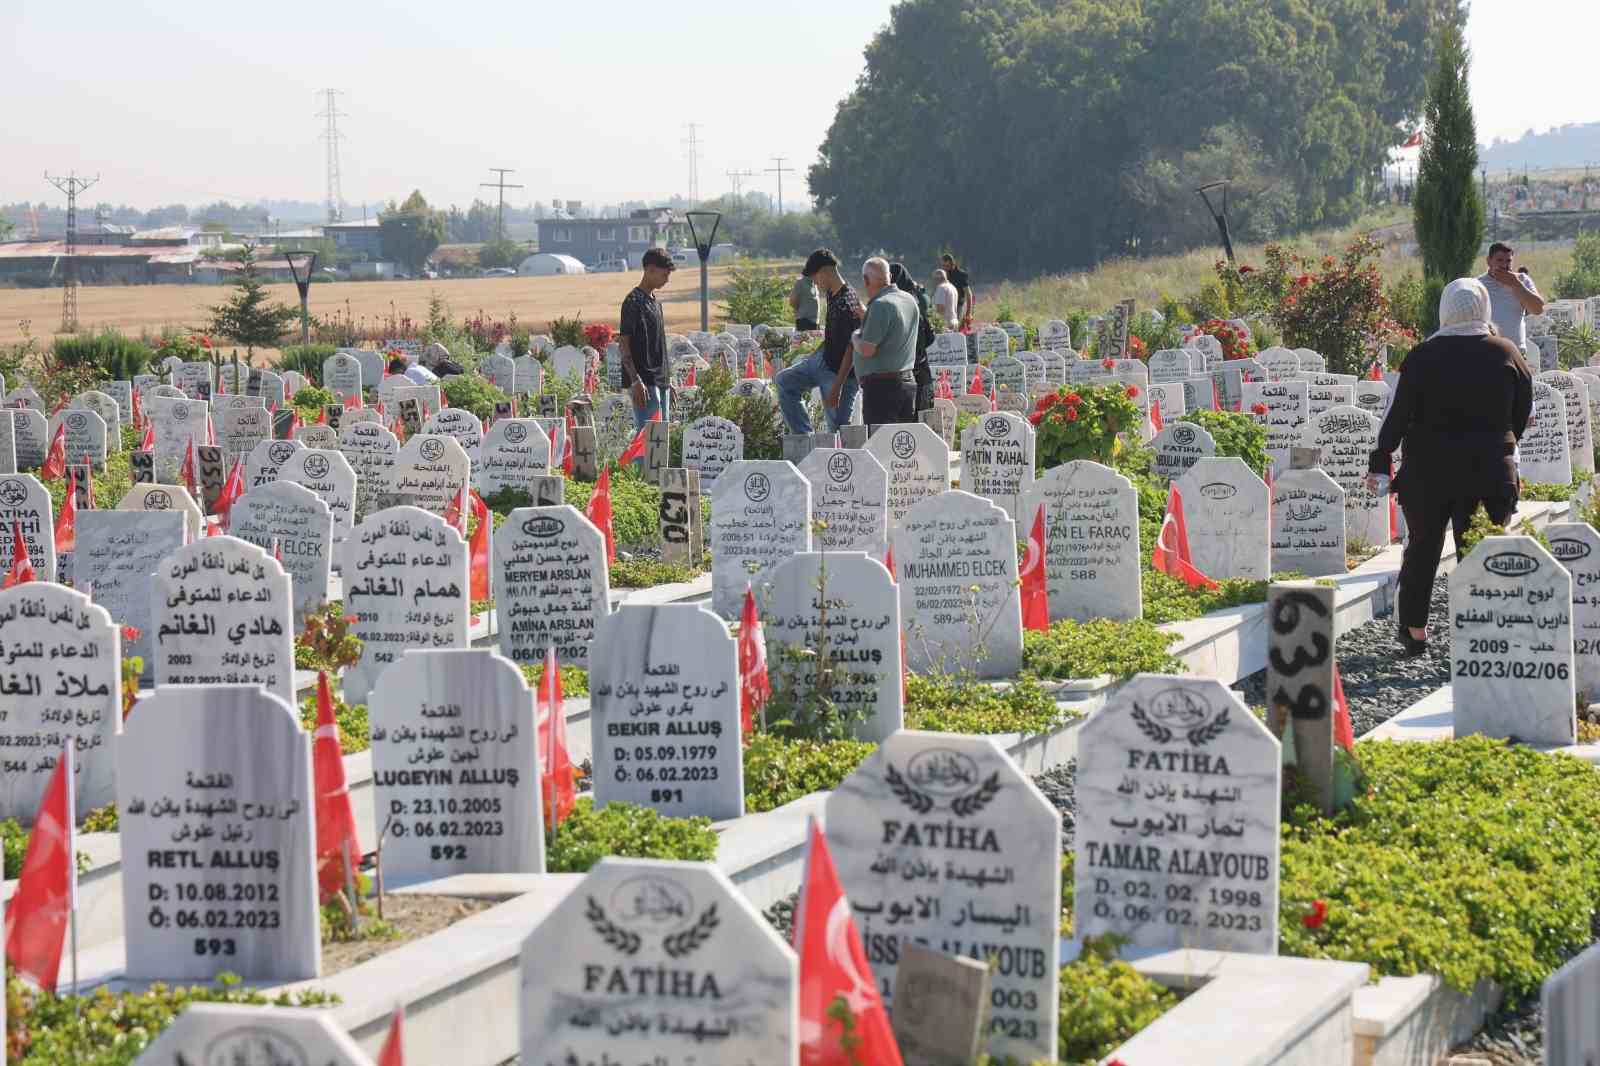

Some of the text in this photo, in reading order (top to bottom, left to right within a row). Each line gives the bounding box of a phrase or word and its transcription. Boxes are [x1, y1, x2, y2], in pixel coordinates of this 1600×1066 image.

[996, 451, 1029, 465] RAHAL
[361, 526, 386, 544] الموت
[413, 527, 432, 541] نفس
[1071, 526, 1131, 541] EL FARAÇ
[284, 539, 323, 557] ELCEK
[171, 558, 198, 579] الموت
[227, 559, 249, 575] نفس
[357, 550, 451, 570] الدعاء للمتوفى
[505, 568, 592, 582] MERYEM ARSLAN
[904, 559, 1007, 580] MUHAMMED ELCEK
[1071, 569, 1097, 581] 588
[167, 588, 271, 608] الدعاء للمتوفى
[348, 577, 461, 606] همام الغانم
[549, 618, 595, 630] ARSLAN
[934, 614, 952, 625] 589
[158, 614, 283, 646] هادي الغانم
[50, 643, 98, 659] الدعاء
[1469, 640, 1509, 653] 2009
[167, 655, 193, 666] 2003
[374, 652, 394, 663] 542
[1456, 659, 1569, 681] 2023/02/06
[682, 684, 709, 699] روح
[470, 727, 497, 743] روح
[665, 720, 723, 738] ALLUŞ
[614, 746, 717, 761] D: 05.09.1979
[1127, 748, 1231, 776] FATİHA
[4, 760, 27, 772] 544
[614, 765, 718, 781] Ö: 06.02.2023
[458, 767, 519, 788] ALLUŞ
[651, 789, 684, 803] 591
[242, 801, 274, 819] روح
[391, 798, 502, 814] D: 23.10.2005
[414, 822, 503, 837] 06.02.2023
[882, 820, 1001, 853] FATİHA
[147, 849, 280, 873] RETL ALLUŞ
[431, 845, 468, 860] 592
[1086, 841, 1269, 880] TAMAR ALAYOUB
[148, 884, 279, 902] D: 10.08.2012
[1095, 877, 1262, 908] D. 02. 02. 1998
[148, 908, 281, 929] Ö: 06.02.2023
[1165, 908, 1198, 927] 02.
[1207, 911, 1262, 932] 2023
[194, 939, 236, 957] 593
[584, 965, 722, 999] FATİHA
